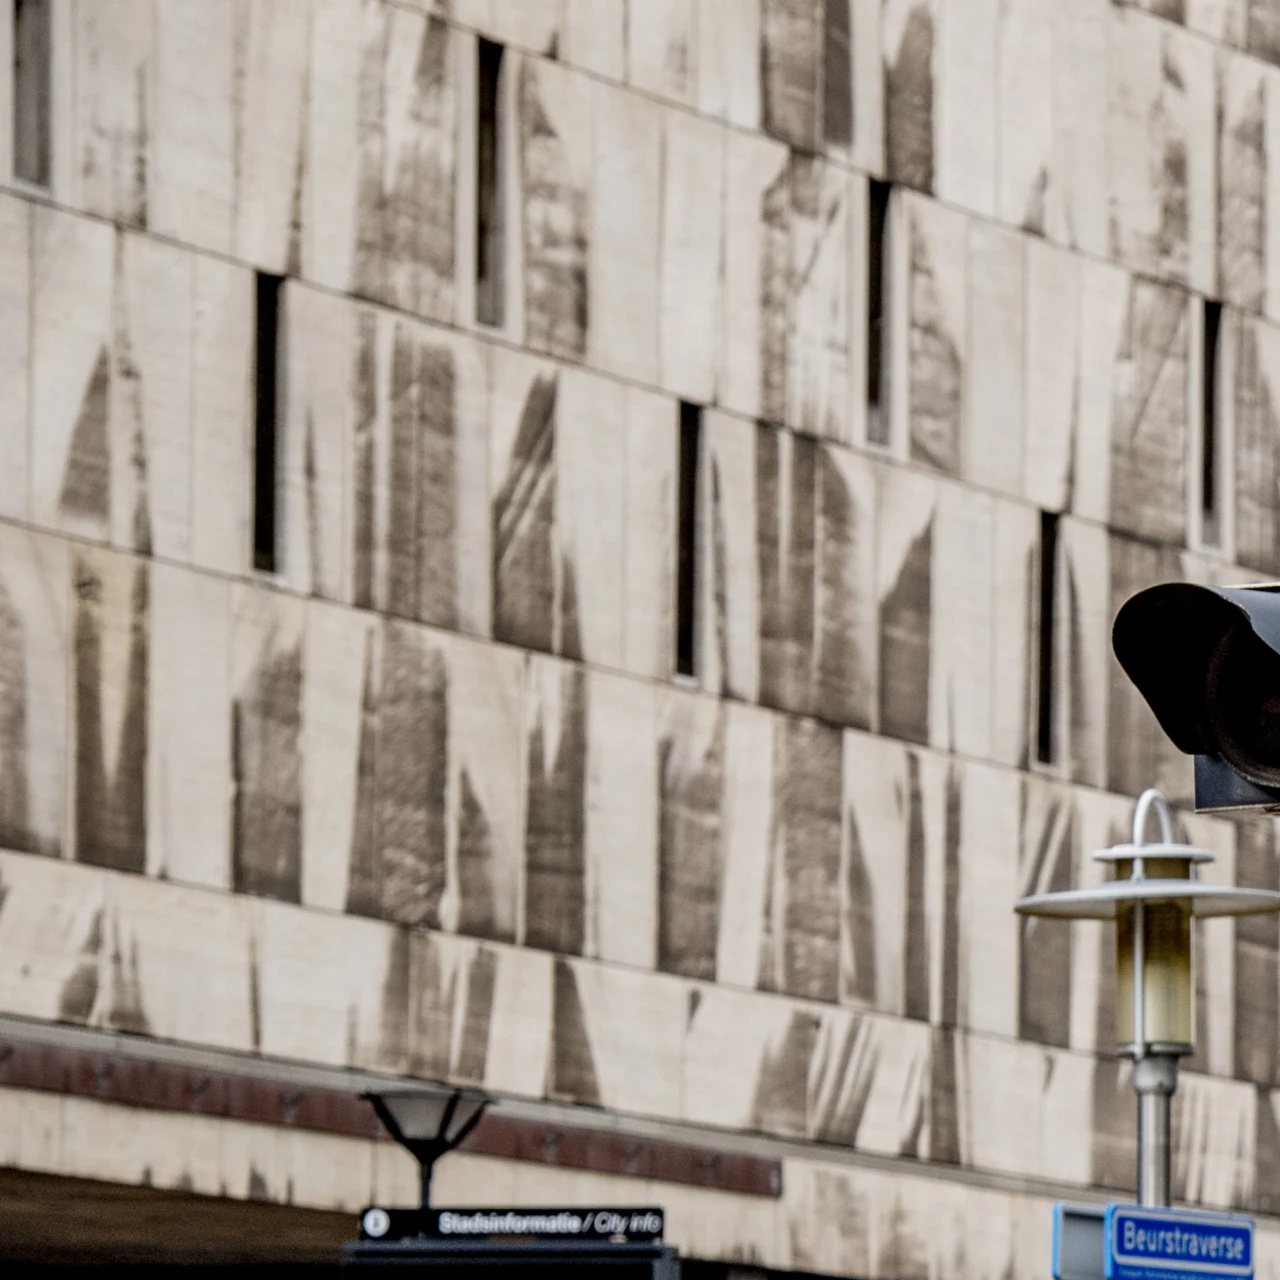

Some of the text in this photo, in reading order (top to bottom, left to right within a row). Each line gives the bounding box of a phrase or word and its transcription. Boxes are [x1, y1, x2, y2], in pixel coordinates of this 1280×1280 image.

[439, 1212, 582, 1234] Stadsinformatie
[594, 1212, 630, 1236] City
[629, 1212, 662, 1233] info
[1123, 1221, 1244, 1260] Beurstraverse
